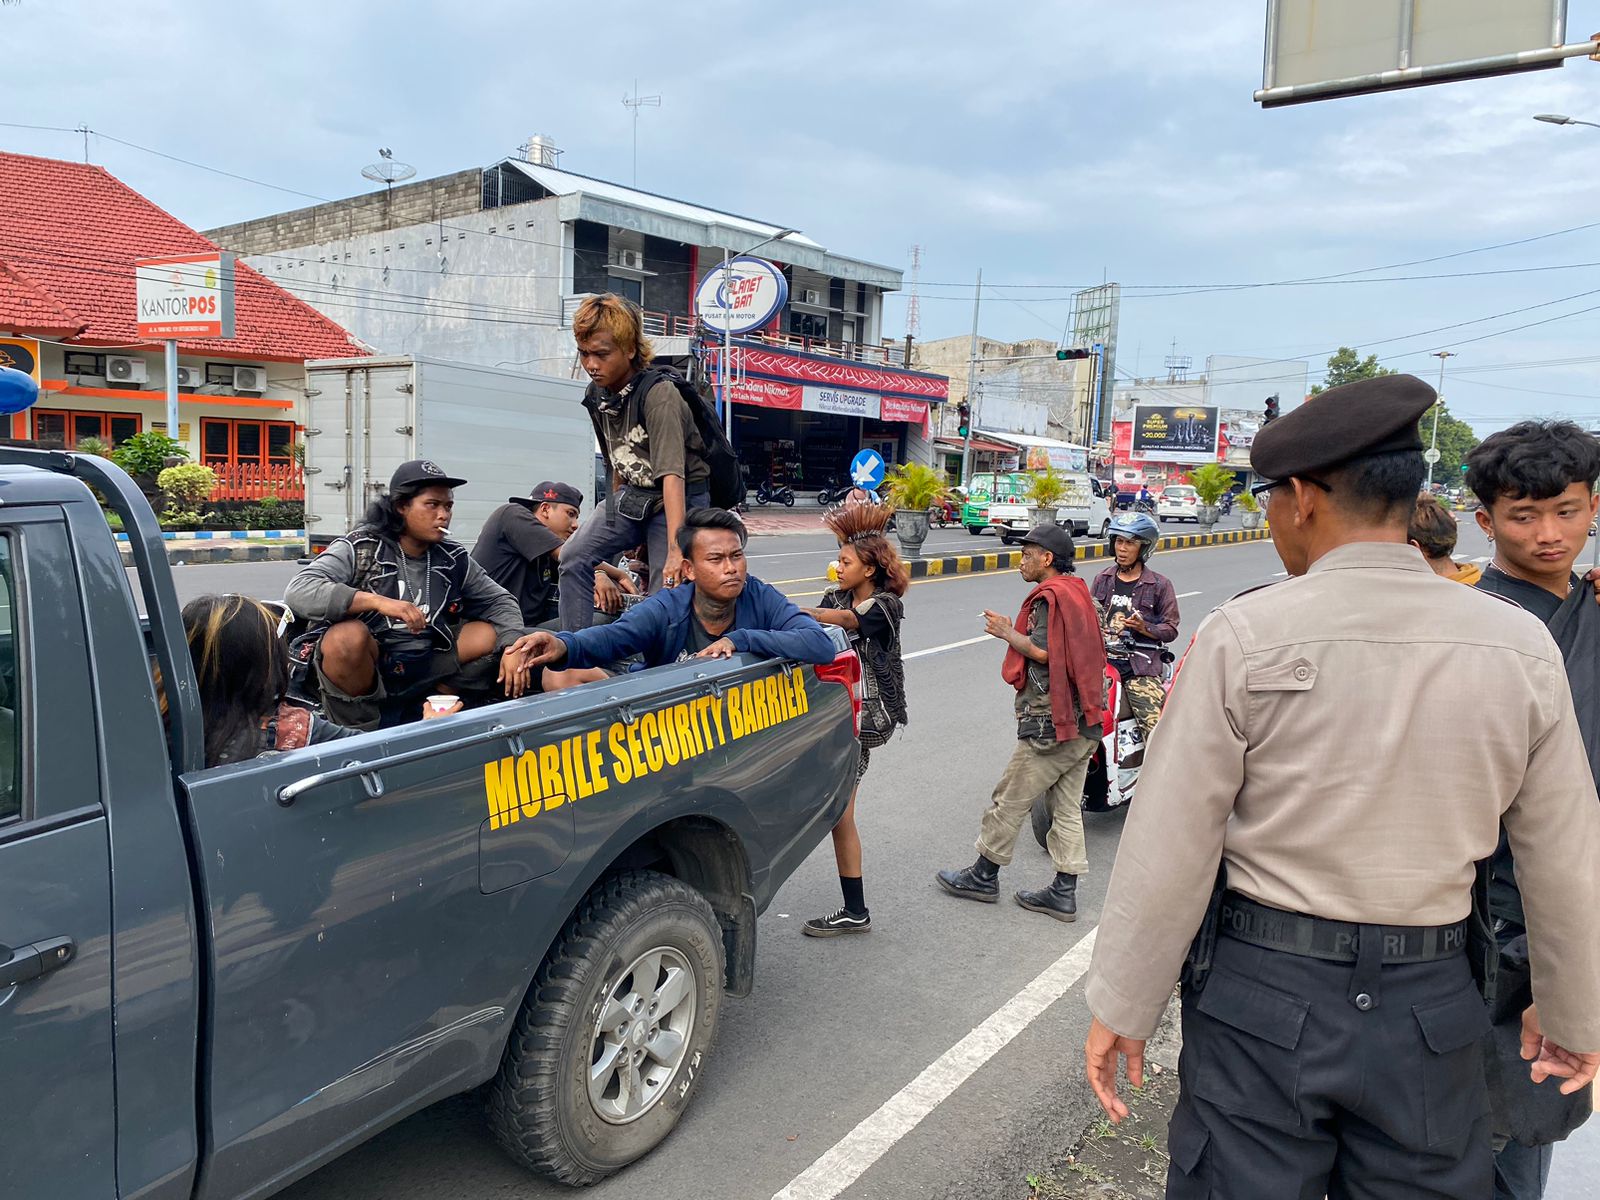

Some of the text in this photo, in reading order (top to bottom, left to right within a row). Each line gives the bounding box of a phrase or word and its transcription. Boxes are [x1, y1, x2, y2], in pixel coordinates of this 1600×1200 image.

[727, 276, 764, 295] LANET
[142, 296, 216, 316] KANTORPOS
[733, 294, 753, 309] BAN
[840, 393, 867, 407] UPGRADE
[484, 666, 809, 831] MOBILE SECURITY BARRIER
